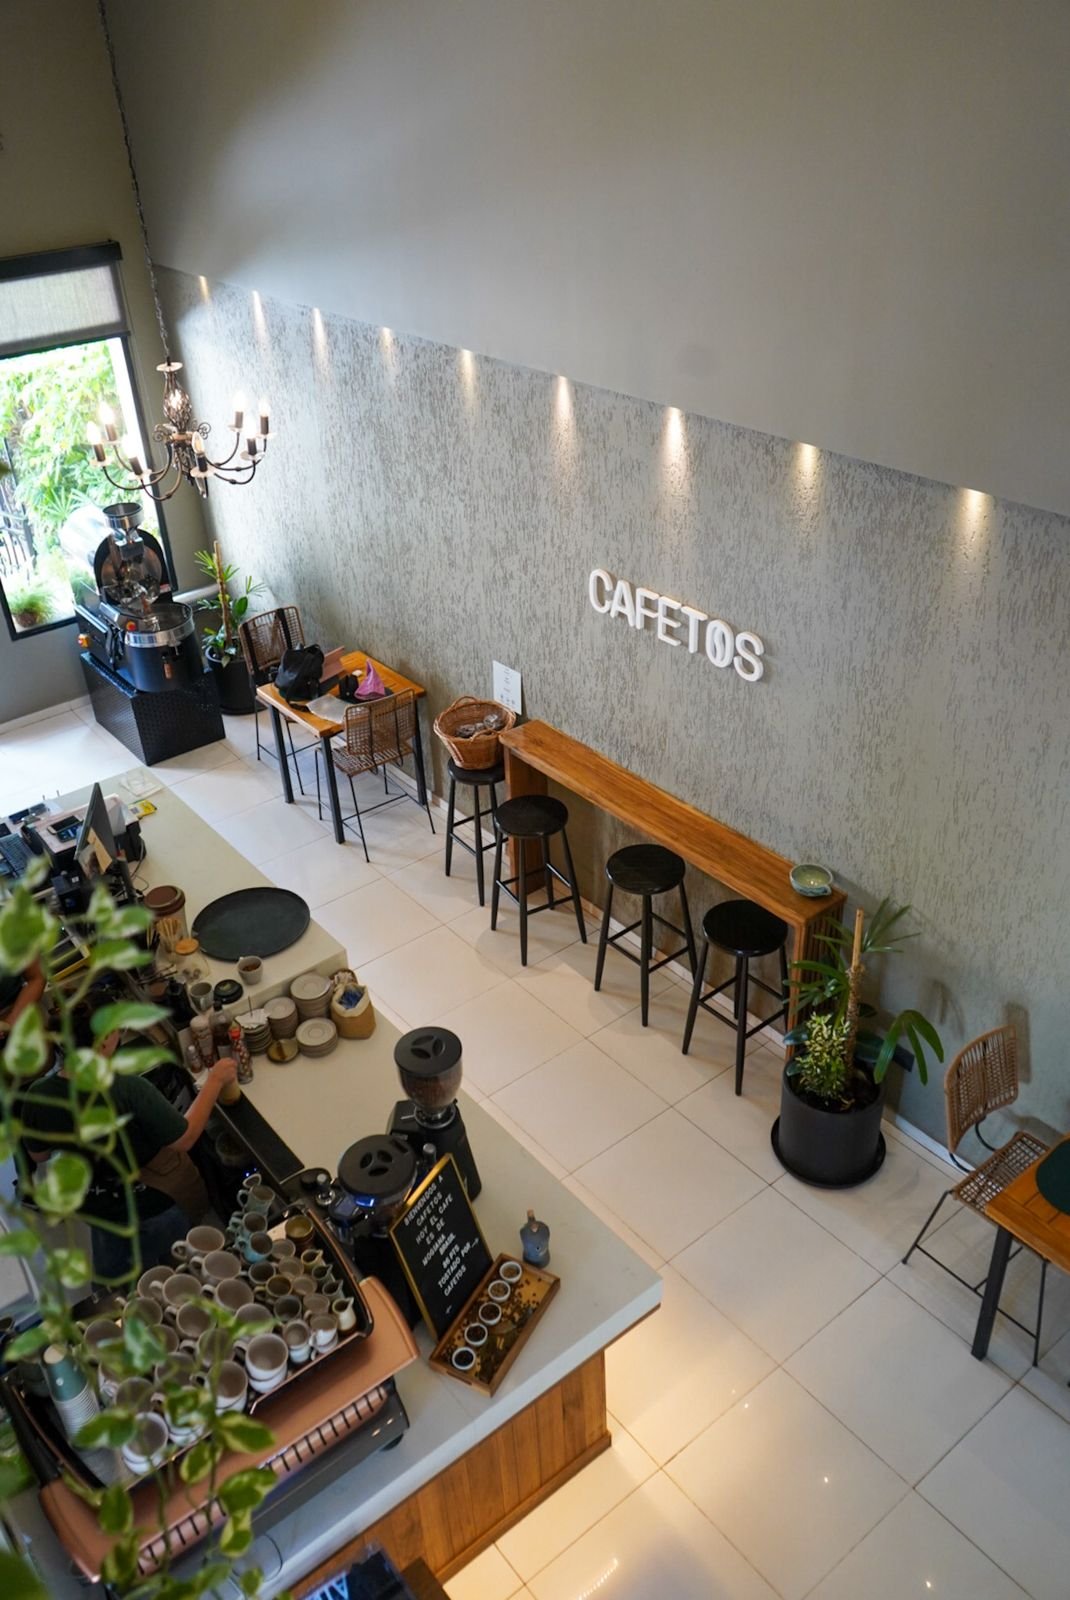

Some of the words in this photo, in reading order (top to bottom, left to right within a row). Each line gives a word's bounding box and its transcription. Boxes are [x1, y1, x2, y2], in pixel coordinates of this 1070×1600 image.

[589, 569, 764, 682] CAFETOS
[416, 1191, 443, 1226] CAFETOS
[416, 1225, 428, 1245] HOY
[430, 1215, 438, 1226] EL
[426, 1232, 435, 1245] ES
[436, 1217, 445, 1231] DE
[438, 1256, 461, 1288] TOSTADO
[444, 1264, 467, 1296] CAFETOS
